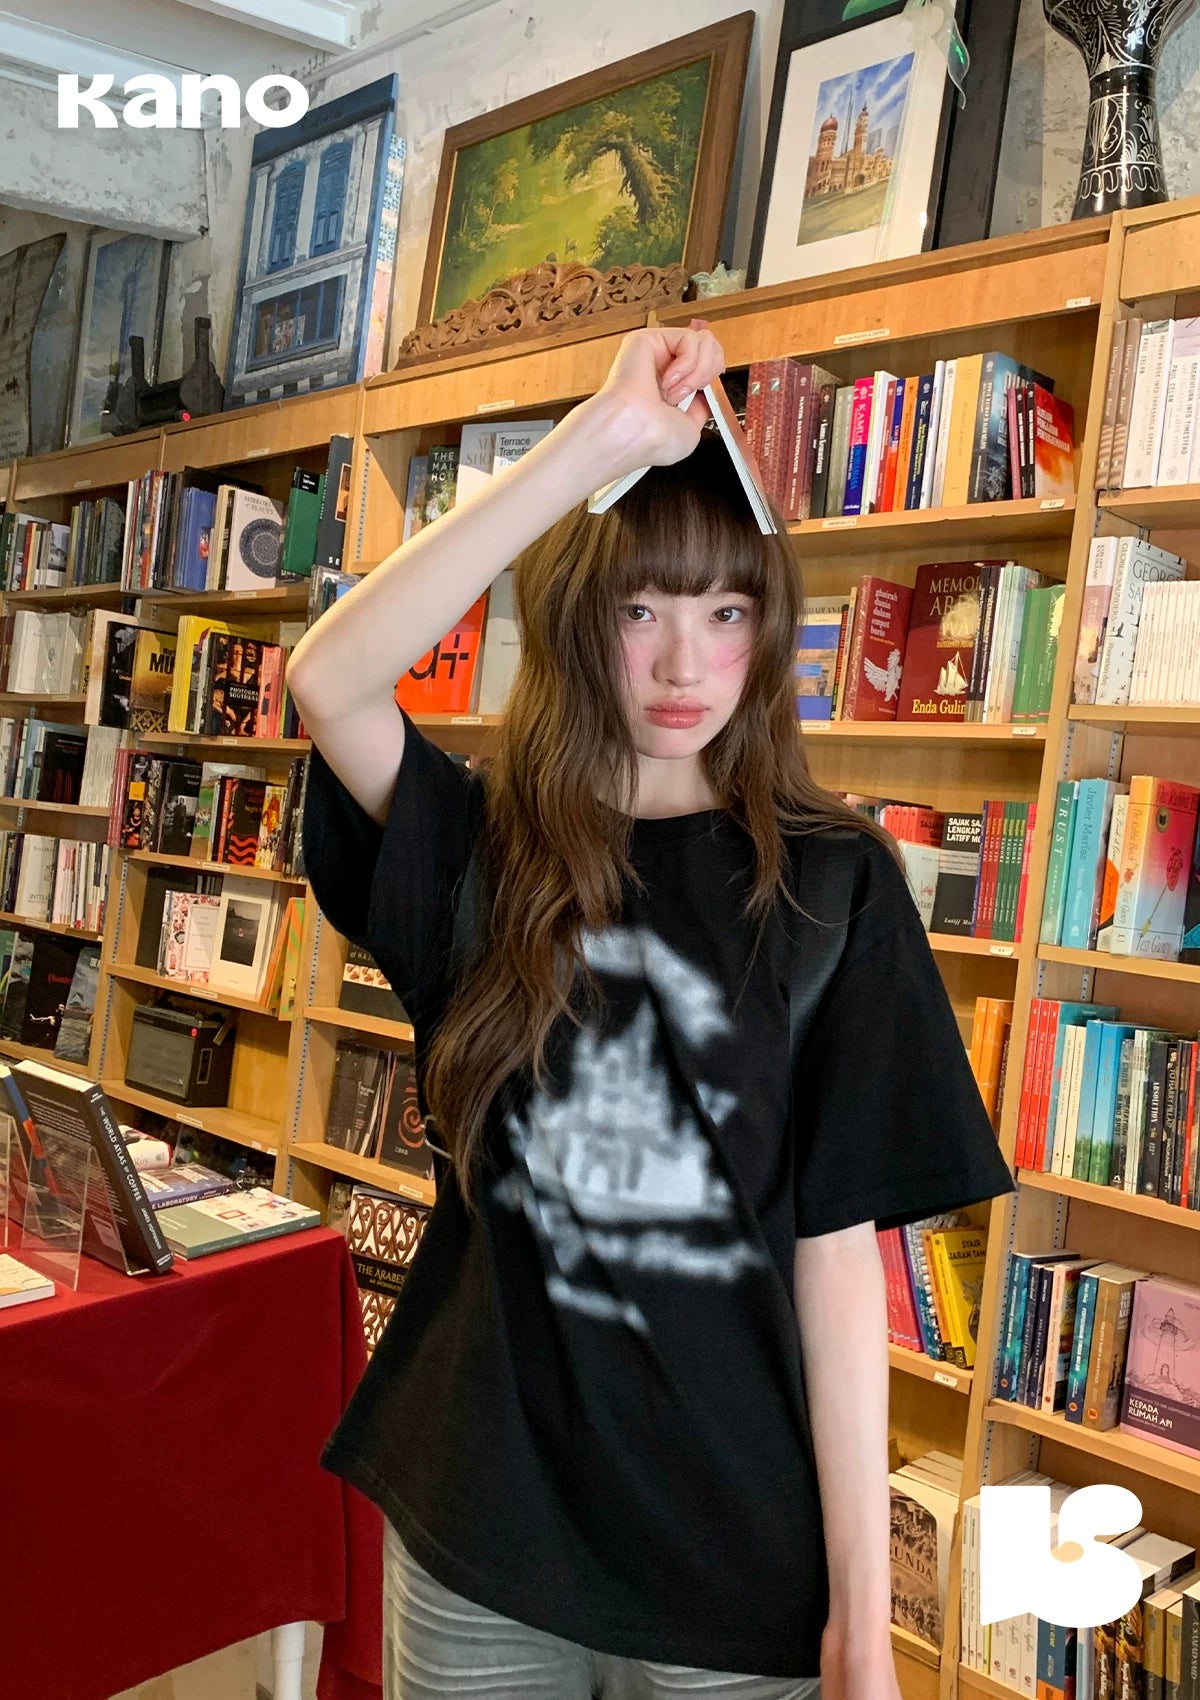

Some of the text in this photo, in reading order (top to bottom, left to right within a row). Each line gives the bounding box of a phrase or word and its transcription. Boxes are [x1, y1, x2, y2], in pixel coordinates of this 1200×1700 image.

[1167, 364, 1177, 402] PAUL CELAN
[1186, 362, 1197, 402] BREATHTURN
[853, 403, 866, 444] KAMUS
[500, 437, 531, 446] Terrace
[1180, 419, 1190, 454] TIMESTEAD
[433, 452, 455, 460] THE
[431, 473, 458, 481] HOU
[1117, 542, 1128, 576] GEORGE
[1110, 577, 1122, 621] SAUNDERS
[229, 687, 259, 696] PHOTOGRA
[911, 699, 937, 714] Enda
[1083, 787, 1096, 820] Javier
[947, 826, 980, 835] LENGKAP
[948, 818, 969, 826] SAJAK
[1053, 796, 1069, 856] TRUST
[946, 833, 970, 842] LATIFF
[1149, 1081, 1160, 1123] ABSOLUTION
[1120, 1094, 1130, 1135] OPERATION
[1113, 1117, 1121, 1136] SPOT
[102, 1115, 117, 1143] WORLD
[113, 1142, 127, 1165] ATLAS
[126, 1174, 143, 1202] COFFEE
[140, 1207, 151, 1223] JAMES
[146, 1222, 162, 1249] HOFFMANN
[157, 1193, 198, 1208] LABORATORY
[972, 1250, 986, 1258] TAM
[357, 1263, 406, 1285] THE ARABES
[1129, 1398, 1159, 1414] KEPADA
[1128, 1407, 1158, 1423] RUMAH
[1159, 1417, 1173, 1428] API
